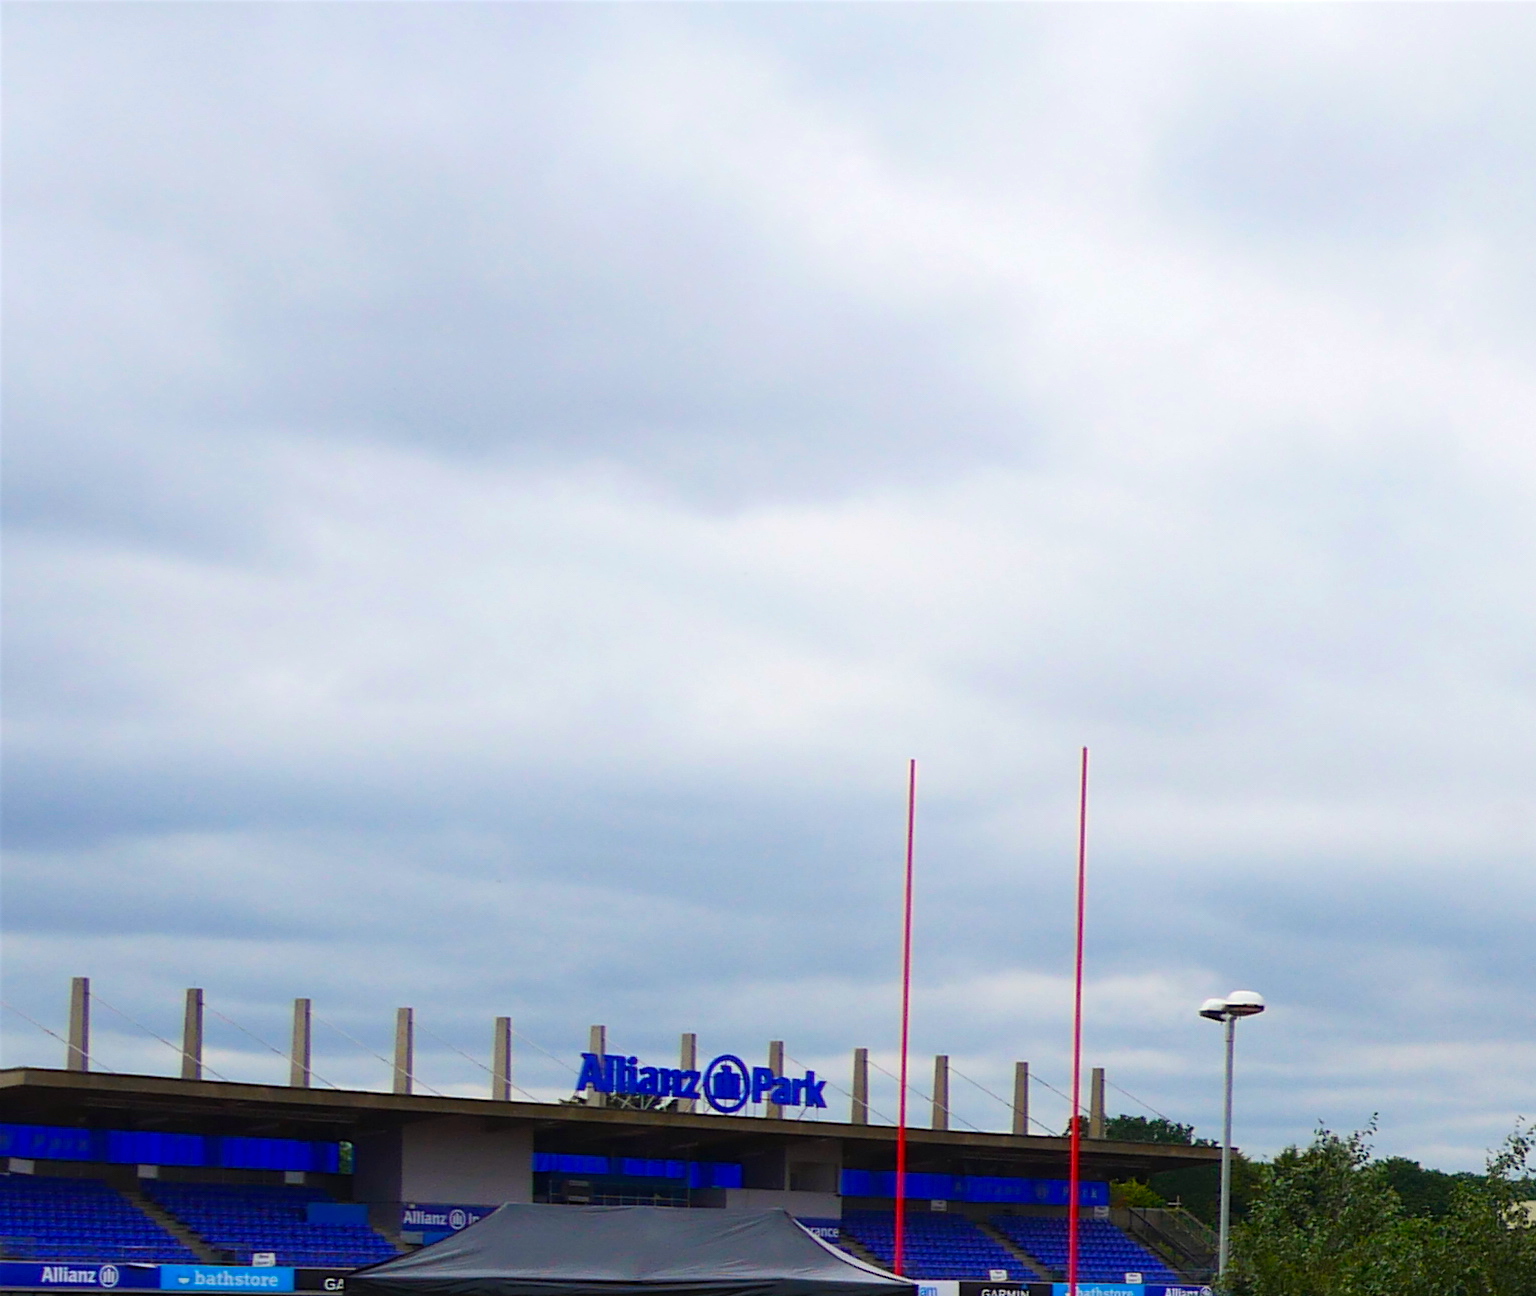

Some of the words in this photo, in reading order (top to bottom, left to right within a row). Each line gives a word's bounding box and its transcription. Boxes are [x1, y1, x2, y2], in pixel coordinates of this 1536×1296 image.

[576, 1052, 702, 1099] Allianz
[751, 1067, 827, 1108] Park
[403, 1210, 447, 1225] Allianz
[809, 1227, 839, 1238] ance
[41, 1266, 97, 1284] Allianz
[194, 1270, 279, 1288] bathstore
[325, 1278, 345, 1291] GA
[920, 1286, 938, 1296] am
